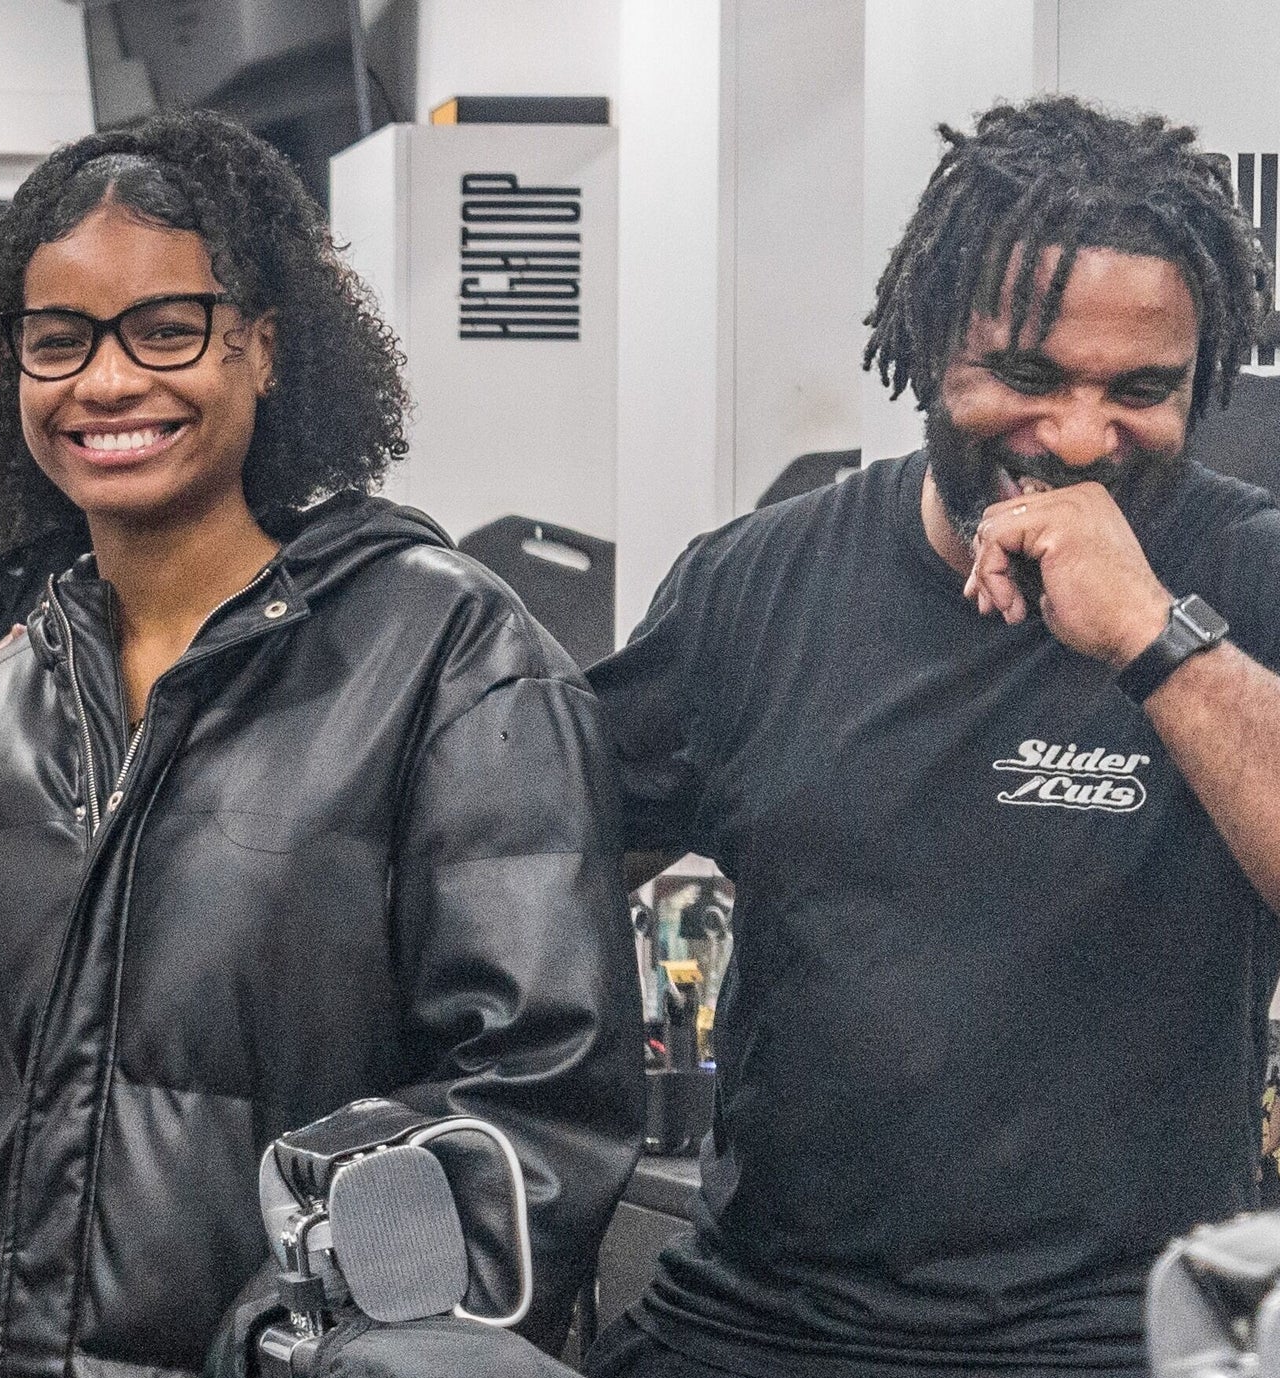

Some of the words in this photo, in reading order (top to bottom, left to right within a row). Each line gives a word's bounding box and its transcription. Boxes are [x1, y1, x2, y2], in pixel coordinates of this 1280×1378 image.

[459, 173, 581, 340] HIGHTOP
[1018, 739, 1151, 774] Slider
[1039, 776, 1136, 807] Cuts
